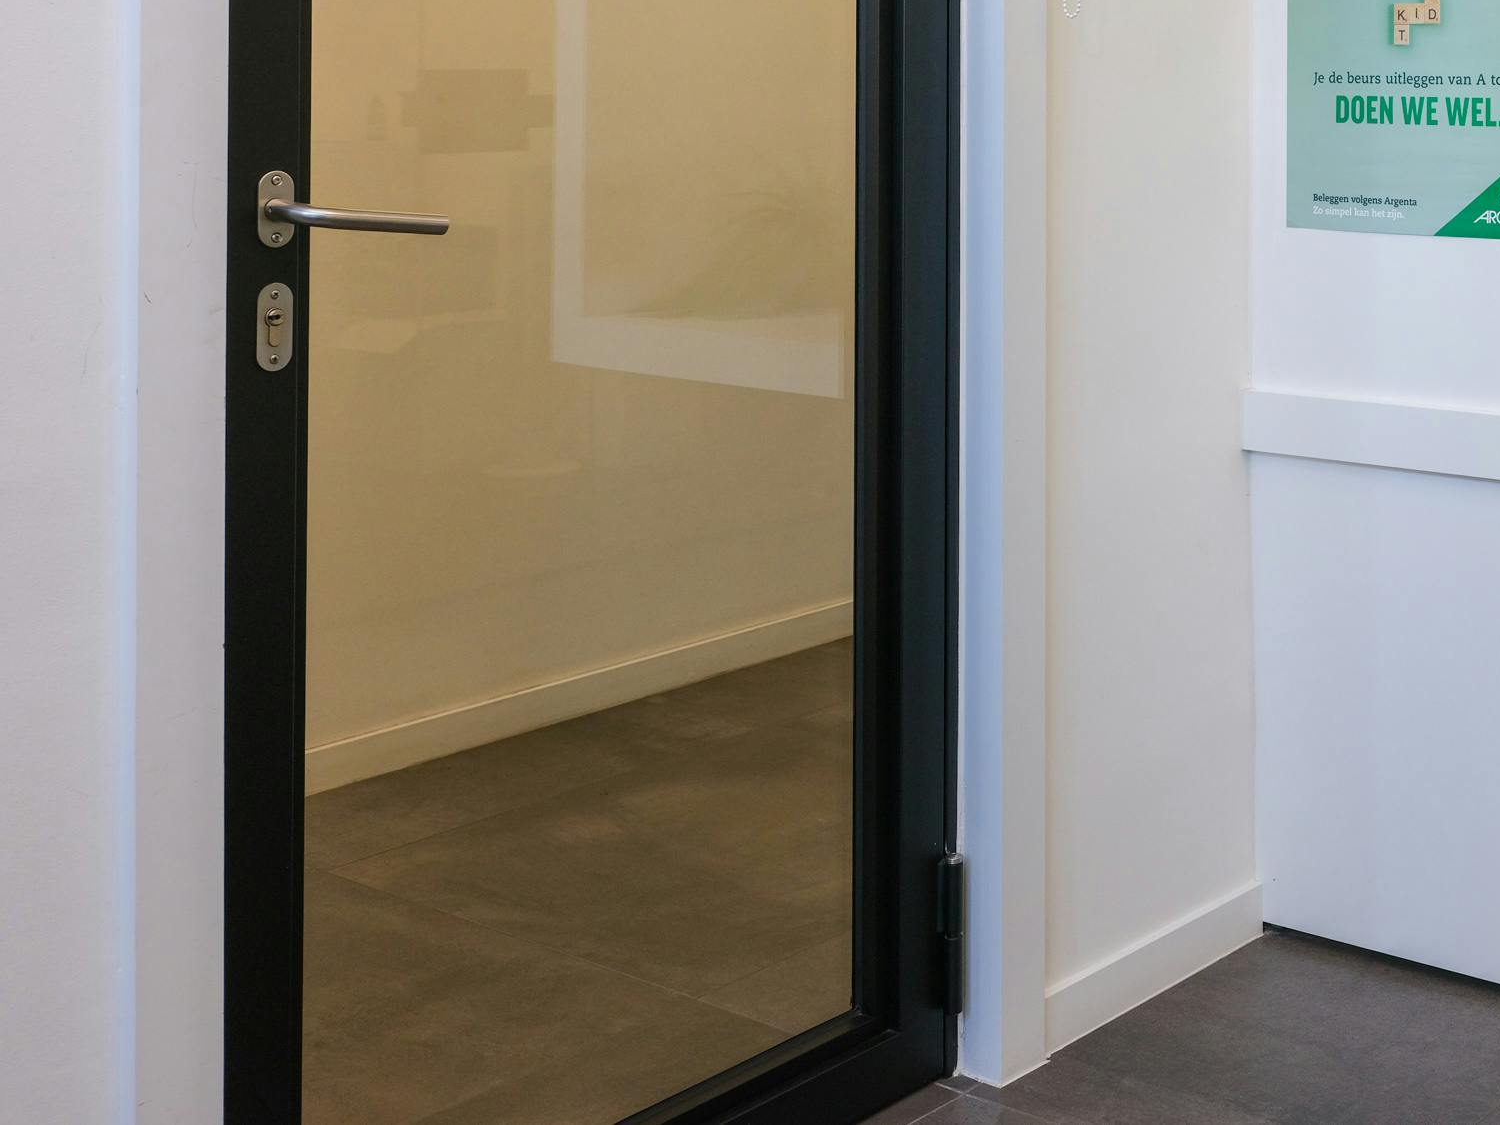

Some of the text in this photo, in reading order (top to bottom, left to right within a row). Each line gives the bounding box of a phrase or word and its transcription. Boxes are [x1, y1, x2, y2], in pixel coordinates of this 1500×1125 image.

[1313, 72, 1325, 86] Je
[1328, 72, 1343, 84] de
[1347, 71, 1381, 84] beurs
[1386, 72, 1444, 89] uitleggen
[1448, 75, 1472, 86] van
[1476, 73, 1486, 86] A
[1335, 95, 1394, 125] DOEN
[1400, 96, 1439, 126] WE
[1313, 193, 1417, 208] Beleggen volgens Argenta
[1312, 205, 1405, 221] Zo simpel kan het zijn.
